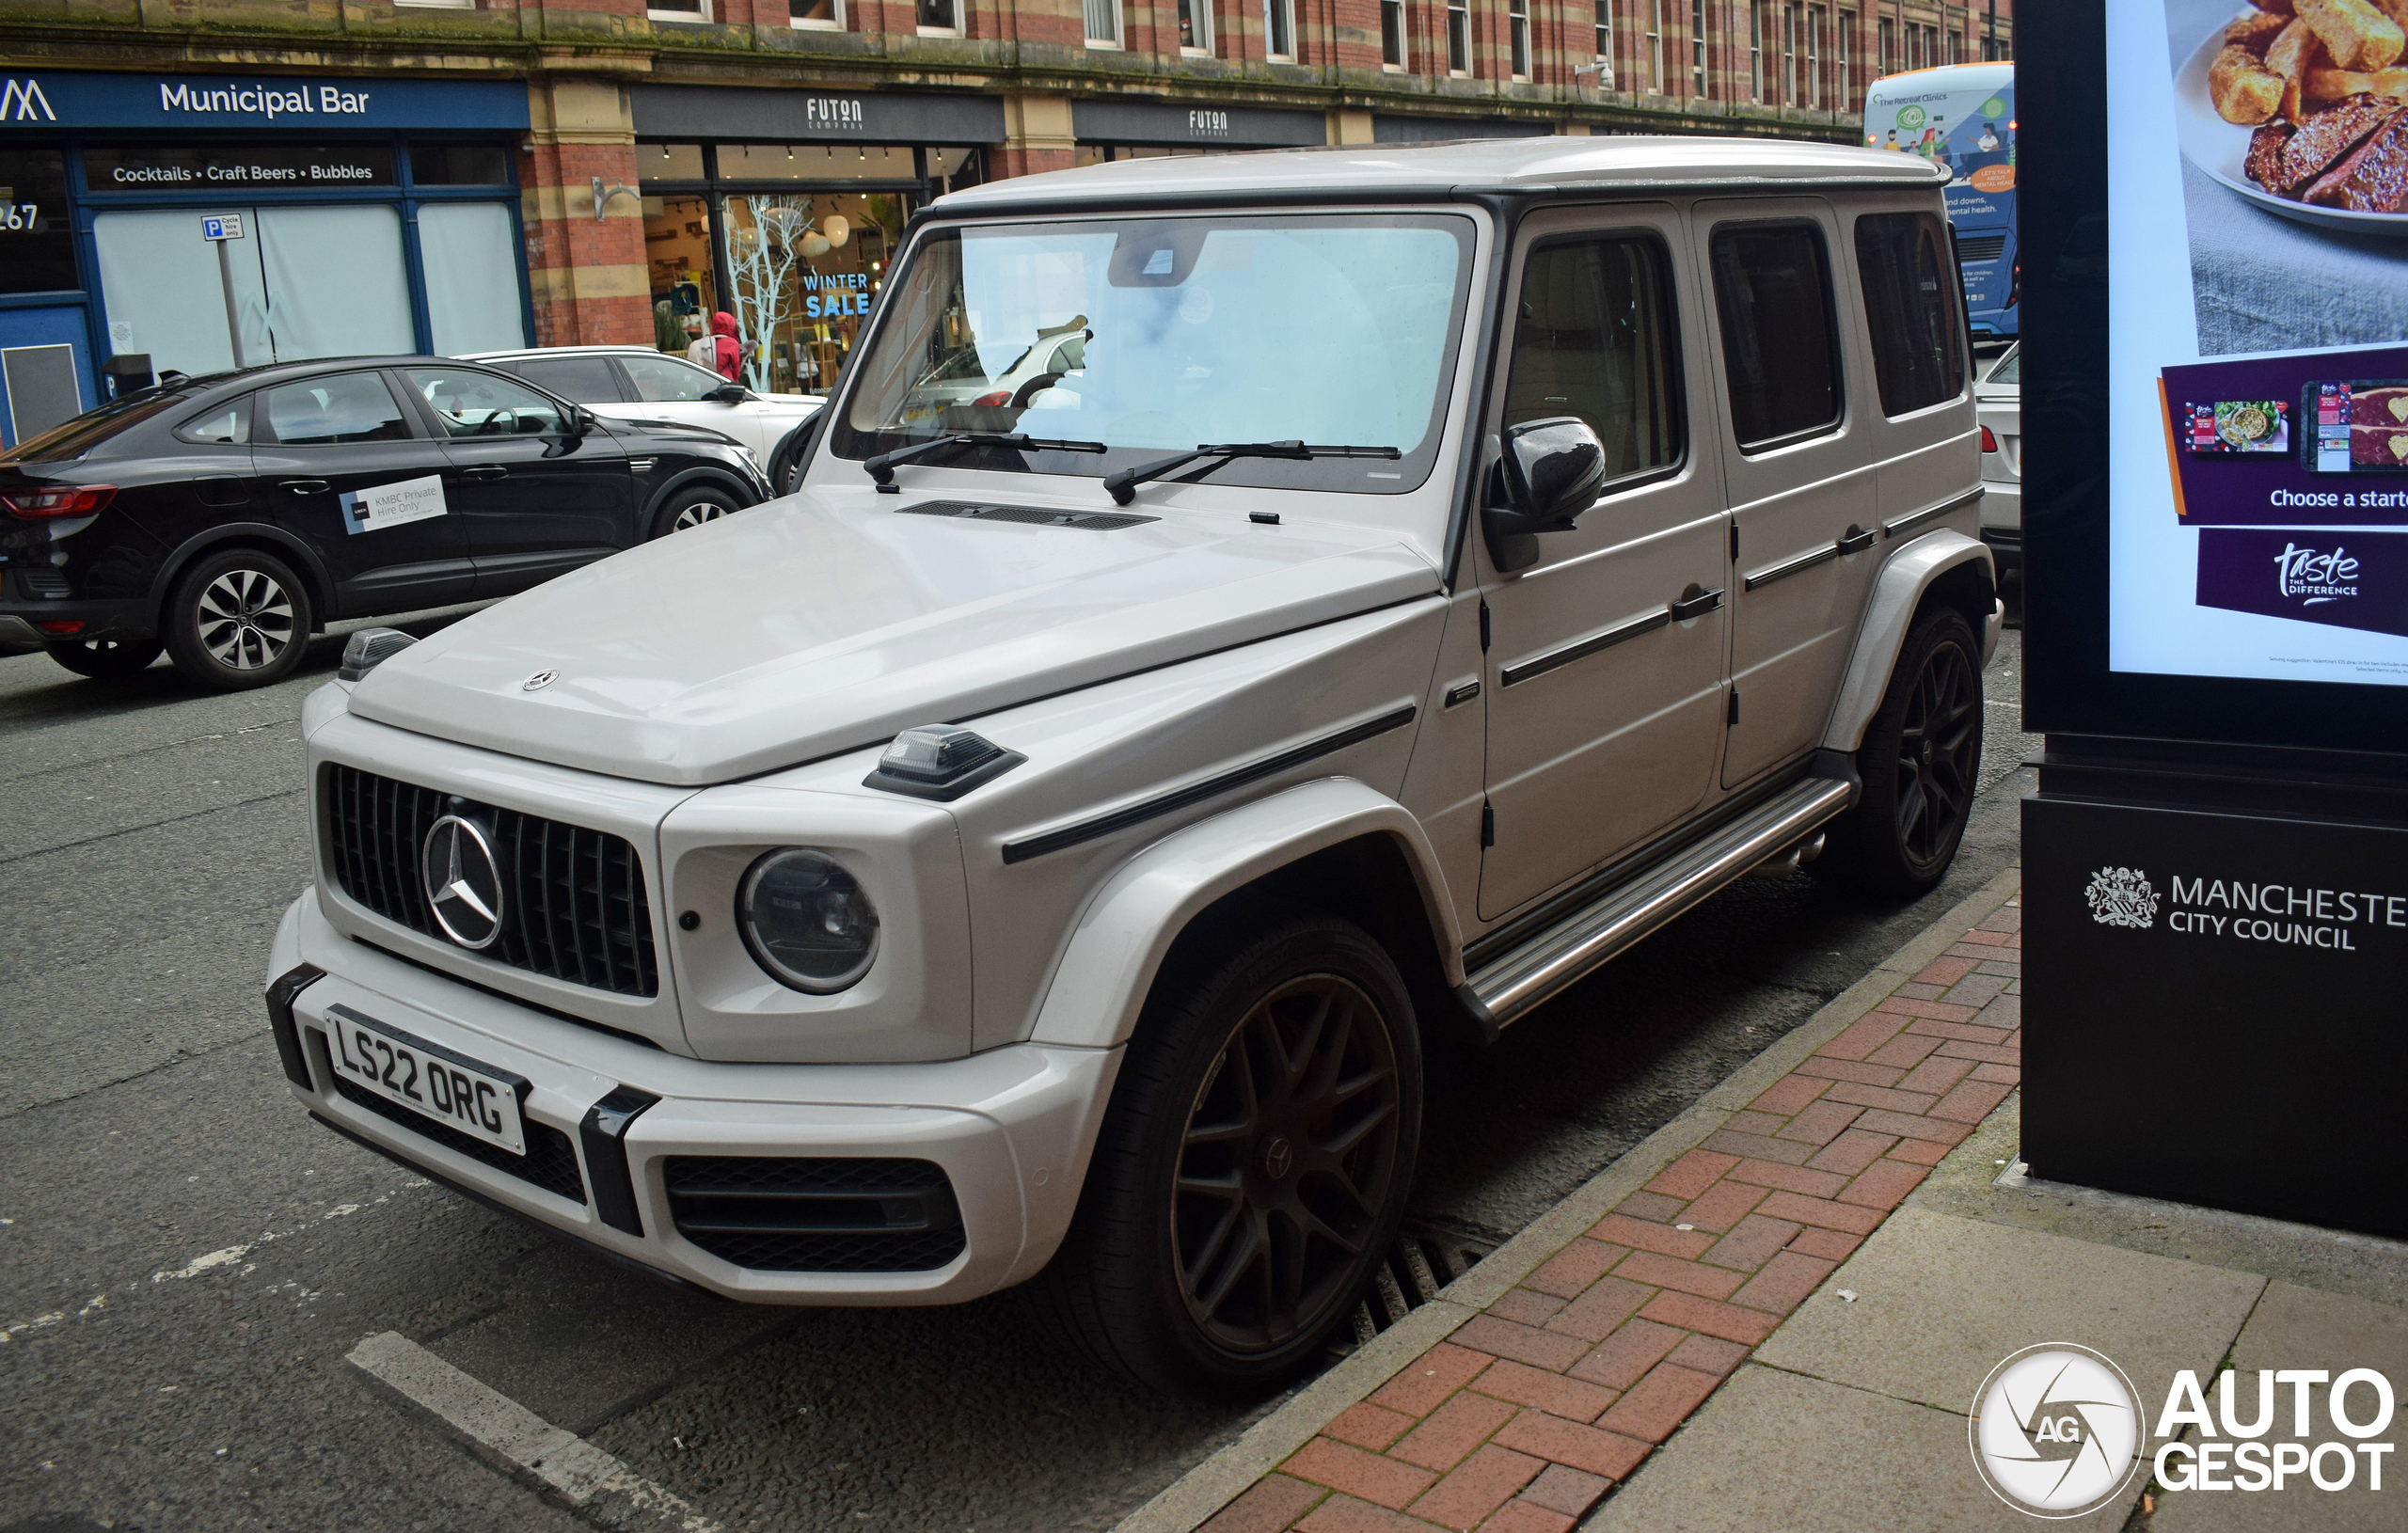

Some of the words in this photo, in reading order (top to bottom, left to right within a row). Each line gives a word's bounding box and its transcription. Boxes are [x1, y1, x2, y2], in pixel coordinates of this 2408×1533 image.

[160, 84, 314, 119] Municipal
[320, 86, 370, 113] Bar
[1894, 95, 1921, 104] Retreat
[1922, 93, 1947, 102] Clinics
[807, 98, 862, 121] FUTON
[809, 121, 863, 130] COMPANY
[1189, 110, 1227, 130] FUTON
[113, 166, 191, 182] Cocktails
[207, 166, 248, 180] Craft
[251, 166, 296, 180] Beers
[310, 165, 372, 179] Bubbles
[1959, 197, 1987, 205] downs,
[1972, 205, 1997, 213] health.
[803, 274, 868, 292] WINTER
[805, 292, 870, 319] SALE
[375, 494, 404, 507] KMBC
[404, 487, 437, 500] Private
[2270, 488, 2338, 507] Choose
[2342, 493, 2355, 507] a
[2359, 490, 2408, 507] start
[377, 506, 397, 517] Hire
[399, 501, 420, 514] Only
[2273, 542, 2359, 597] taste
[2289, 585, 2358, 595] DIFFERENCE
[2169, 910, 2227, 936] CITY
[2233, 918, 2356, 951] COUNCIL
[335, 1019, 423, 1102] LS22
[427, 1060, 503, 1134] ORG
